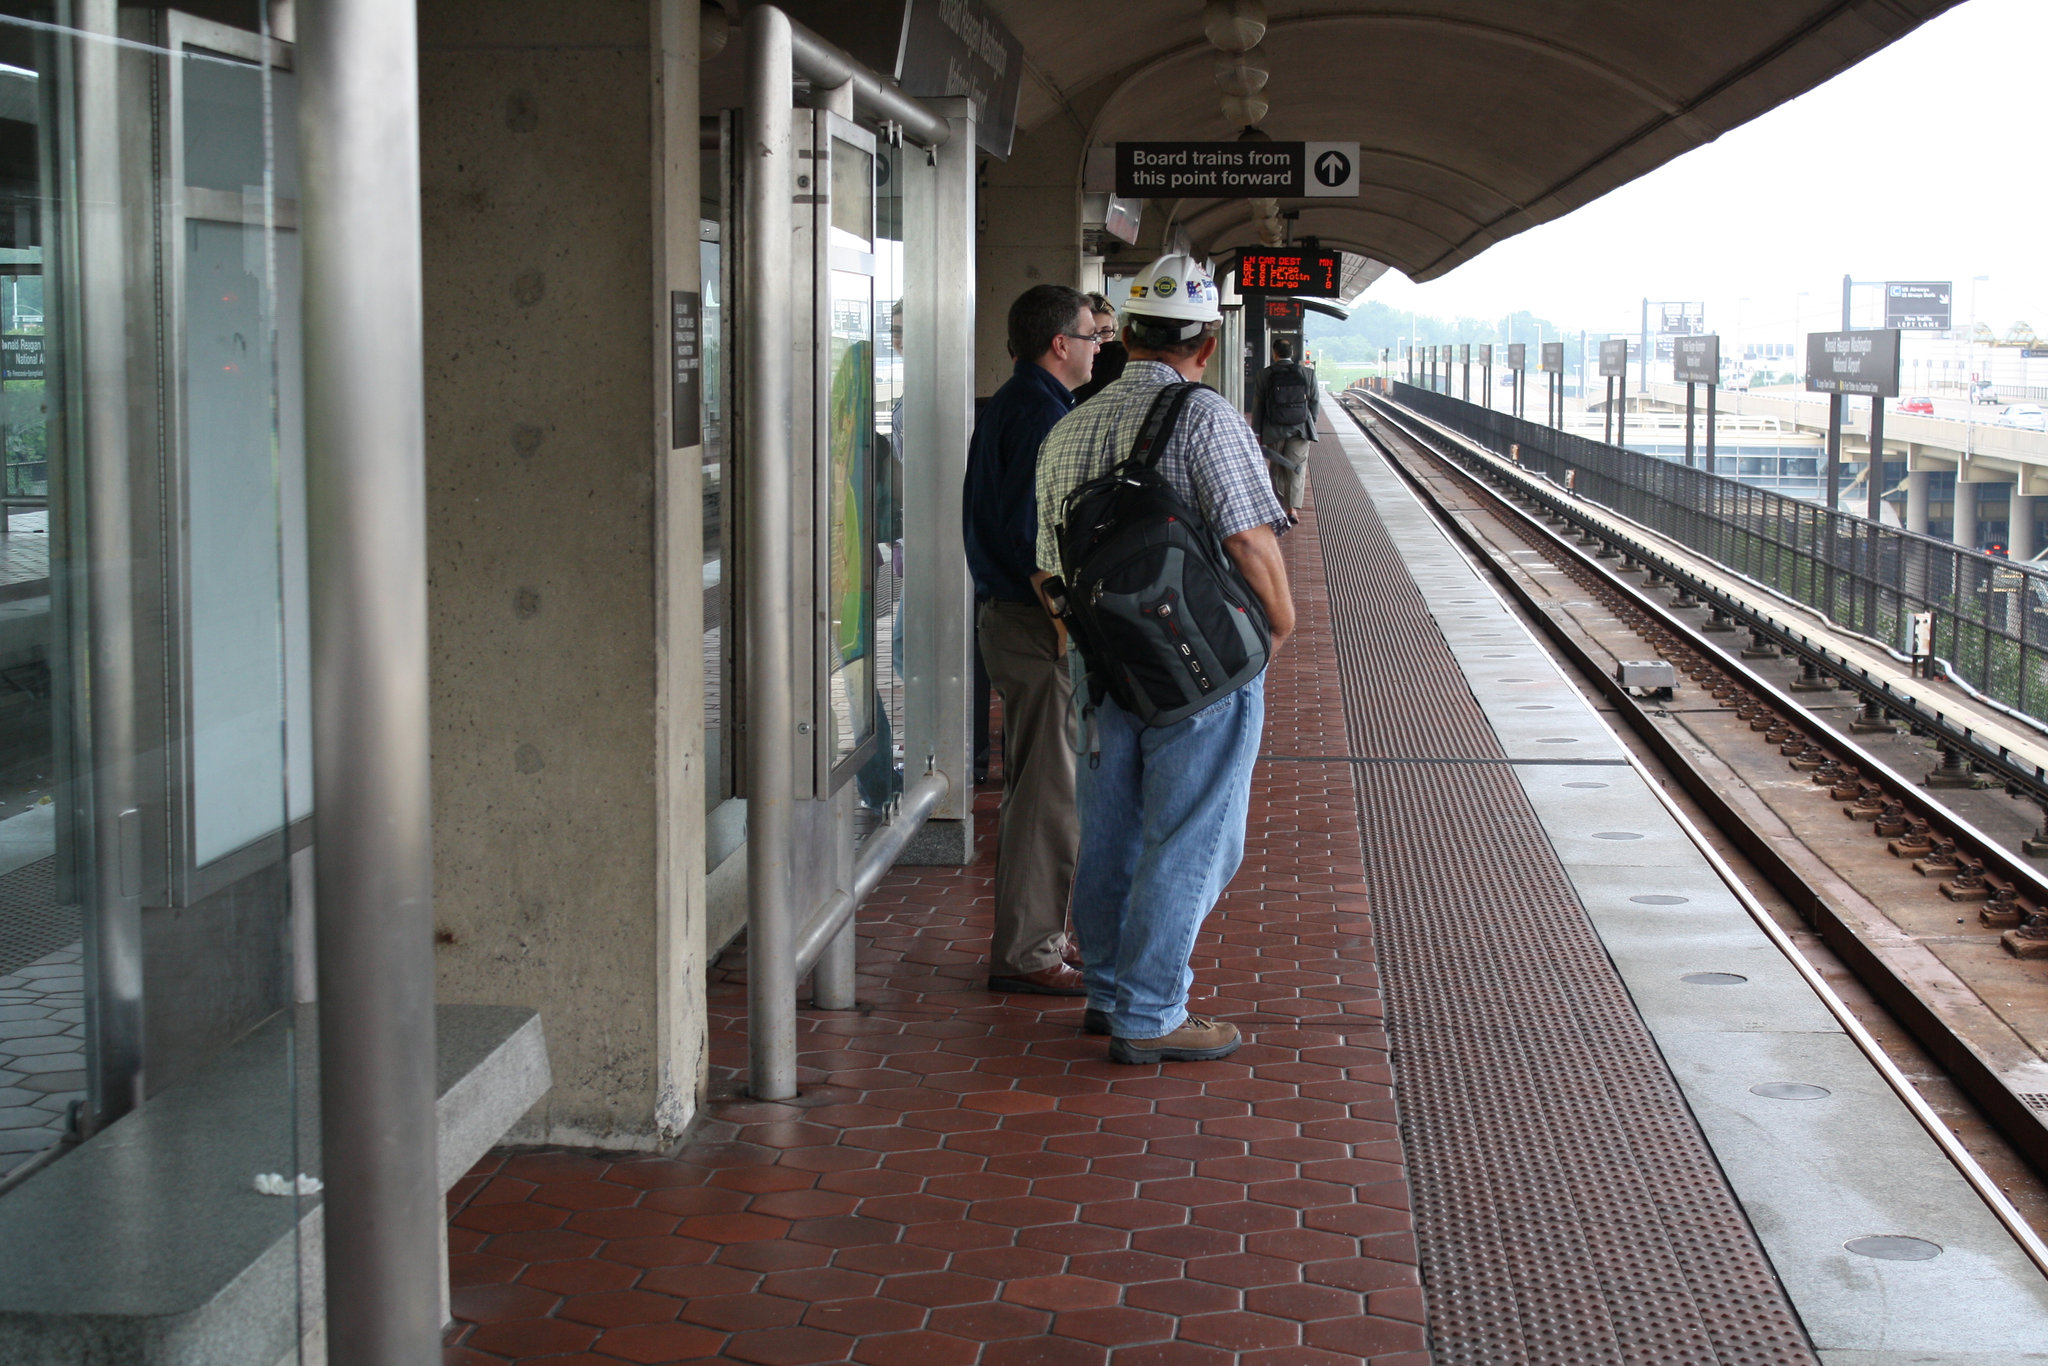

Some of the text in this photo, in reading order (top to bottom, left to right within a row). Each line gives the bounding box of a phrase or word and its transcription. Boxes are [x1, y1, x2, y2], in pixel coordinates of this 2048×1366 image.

[1133, 150, 1290, 165] Board trains from
[1133, 170, 1292, 188] this point forward
[1243, 256, 1256, 264] LN
[1258, 256, 1276, 265] CAR
[1278, 257, 1302, 266] DEST
[1259, 264, 1266, 272] 6
[1271, 265, 1299, 273] Largo
[1327, 266, 1332, 274] 1
[1242, 278, 1332, 289] BL 6 Largo 8
[21, 338, 41, 353] Reagan
[15, 353, 38, 365] National
